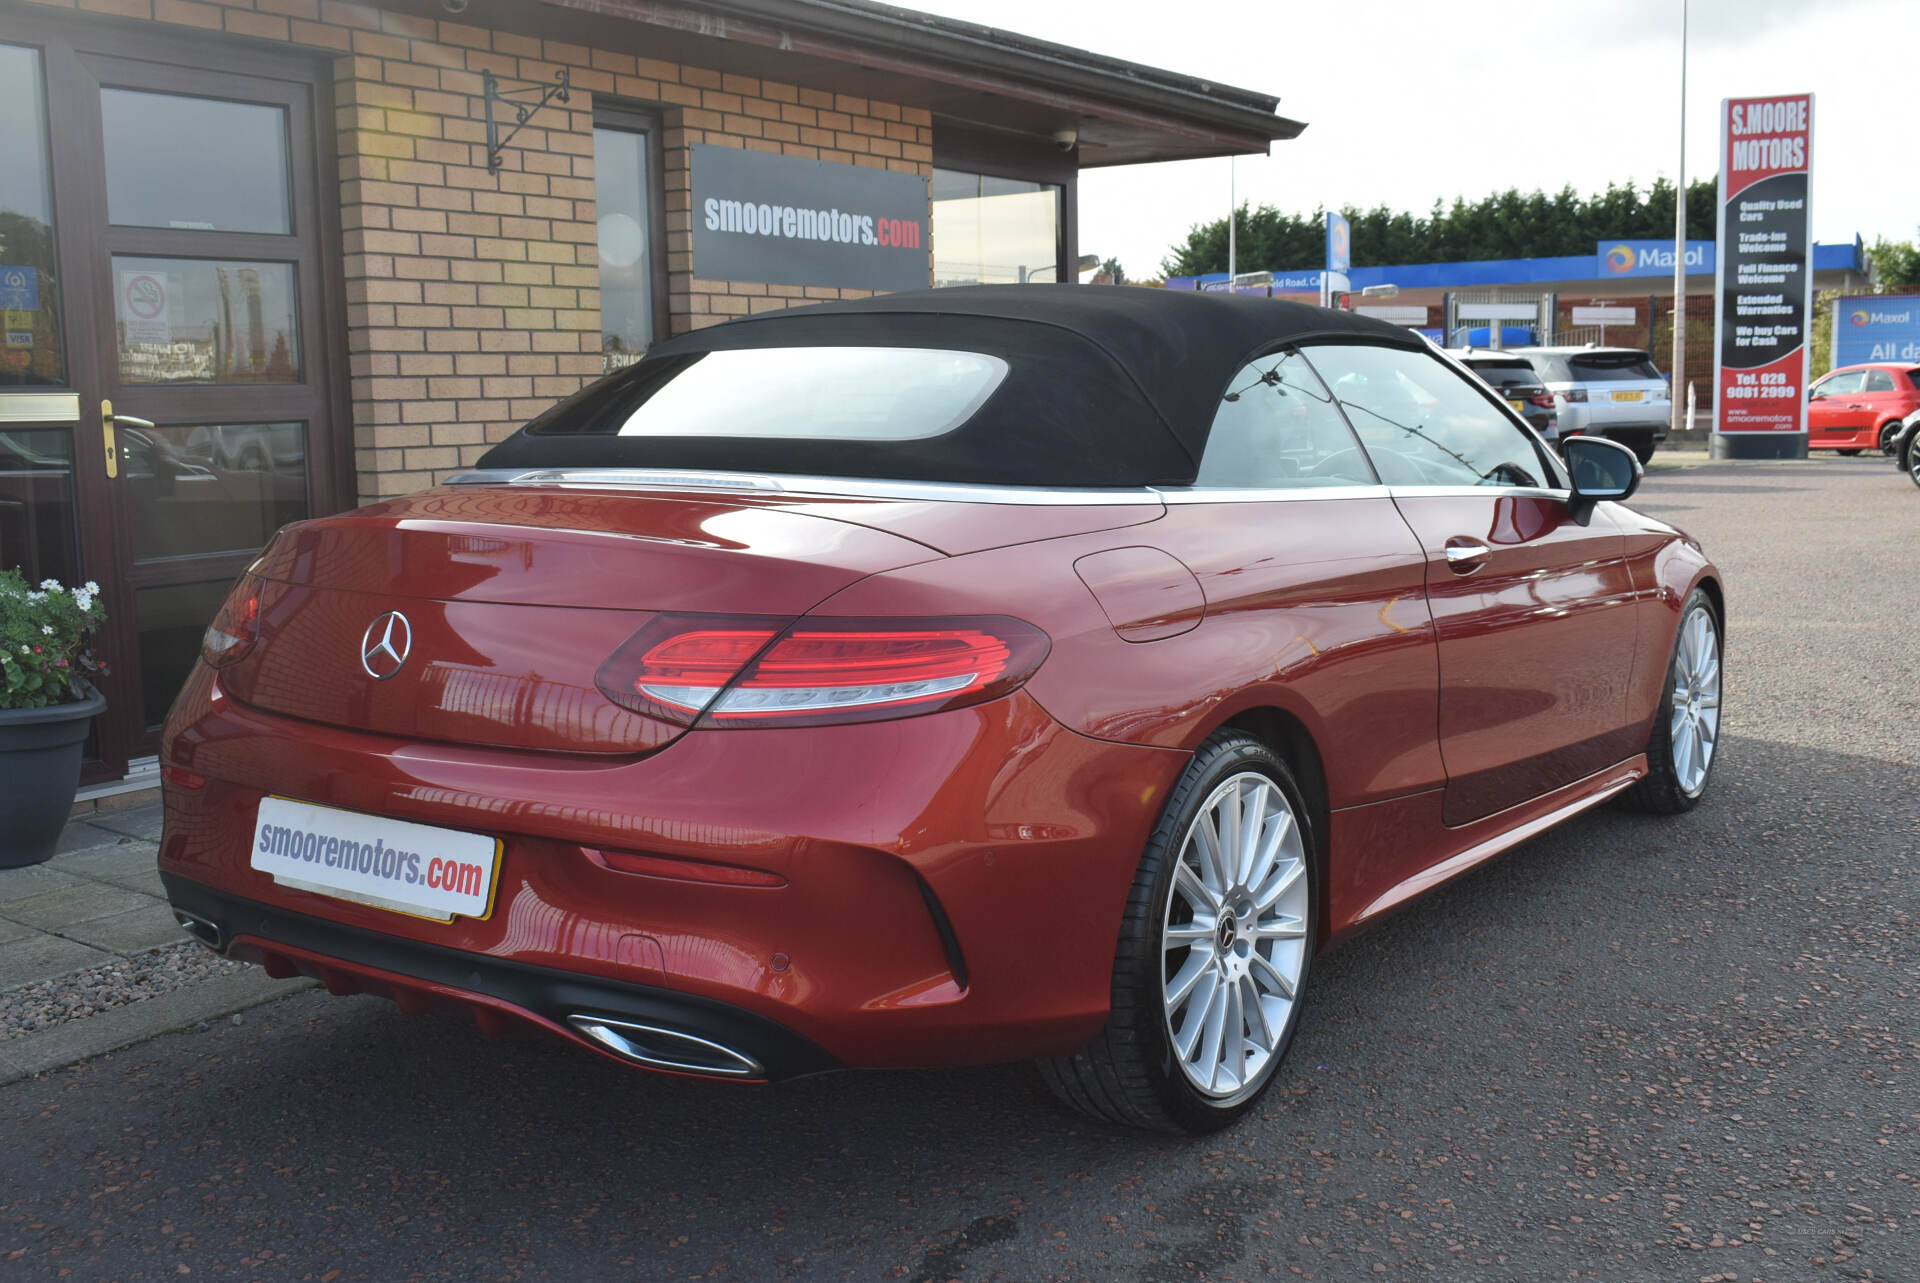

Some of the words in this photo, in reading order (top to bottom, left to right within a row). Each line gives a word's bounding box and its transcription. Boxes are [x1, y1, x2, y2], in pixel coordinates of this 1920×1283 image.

[1732, 100, 1807, 136] S.MOORE
[1733, 136, 1805, 171] MOTORS
[1740, 201, 1776, 211] Quality
[1777, 199, 1803, 210] Used
[704, 197, 921, 249] smooremotors.com
[1740, 212, 1763, 222] Cars
[1738, 243, 1786, 253] Welcome
[1738, 264, 1757, 274] Full
[1758, 263, 1798, 273] Finance
[1737, 274, 1785, 284] Welcome
[1737, 294, 1784, 305] Extended
[1736, 305, 1794, 316] Warranties
[1870, 311, 1910, 324] Maxol
[1735, 326, 1753, 336] We
[1753, 326, 1773, 337] buy
[1774, 325, 1798, 336] Cars
[1735, 337, 1751, 347] for
[1751, 336, 1778, 347] Cash
[1870, 343, 1896, 360] All
[1760, 373, 1787, 385] 028
[1726, 386, 1759, 399] 9081
[1760, 385, 1795, 398] 2999
[1727, 414, 1793, 423] smooremotors
[259, 823, 483, 897] smooremotors.com
